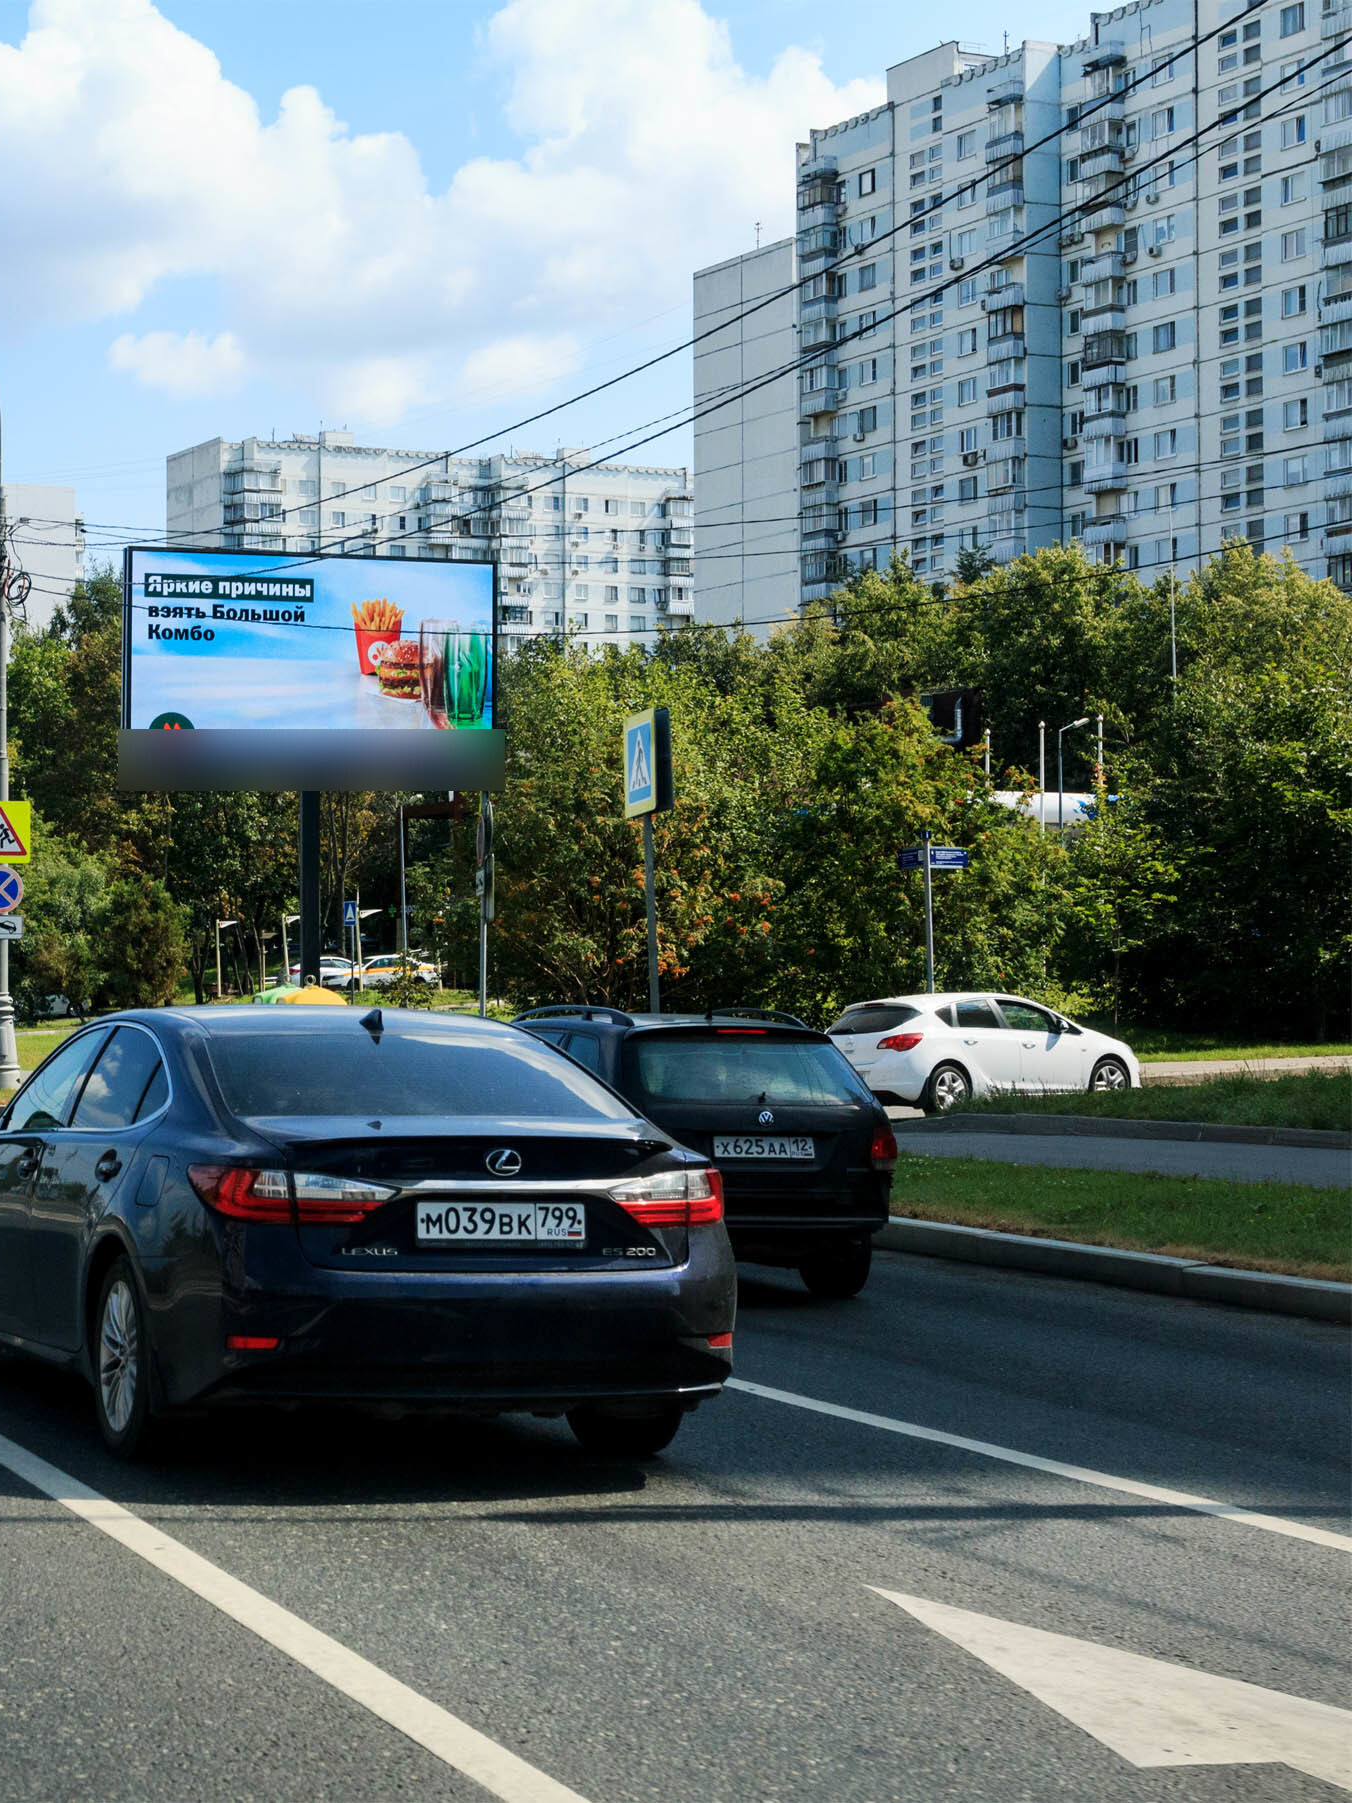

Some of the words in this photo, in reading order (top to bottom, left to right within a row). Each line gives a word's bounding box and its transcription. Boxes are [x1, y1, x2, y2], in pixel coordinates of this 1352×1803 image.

[148, 576, 213, 596] Яркие
[218, 581, 311, 598] причины
[149, 605, 207, 619] взять
[212, 604, 305, 622] Большой
[149, 624, 215, 641] Комбо
[792, 1138, 808, 1152] 12
[538, 1207, 578, 1228] 799
[547, 1228, 567, 1236] RUS
[341, 1248, 399, 1256] LEXUS
[602, 1248, 623, 1256] ES
[626, 1247, 657, 1256] 200
